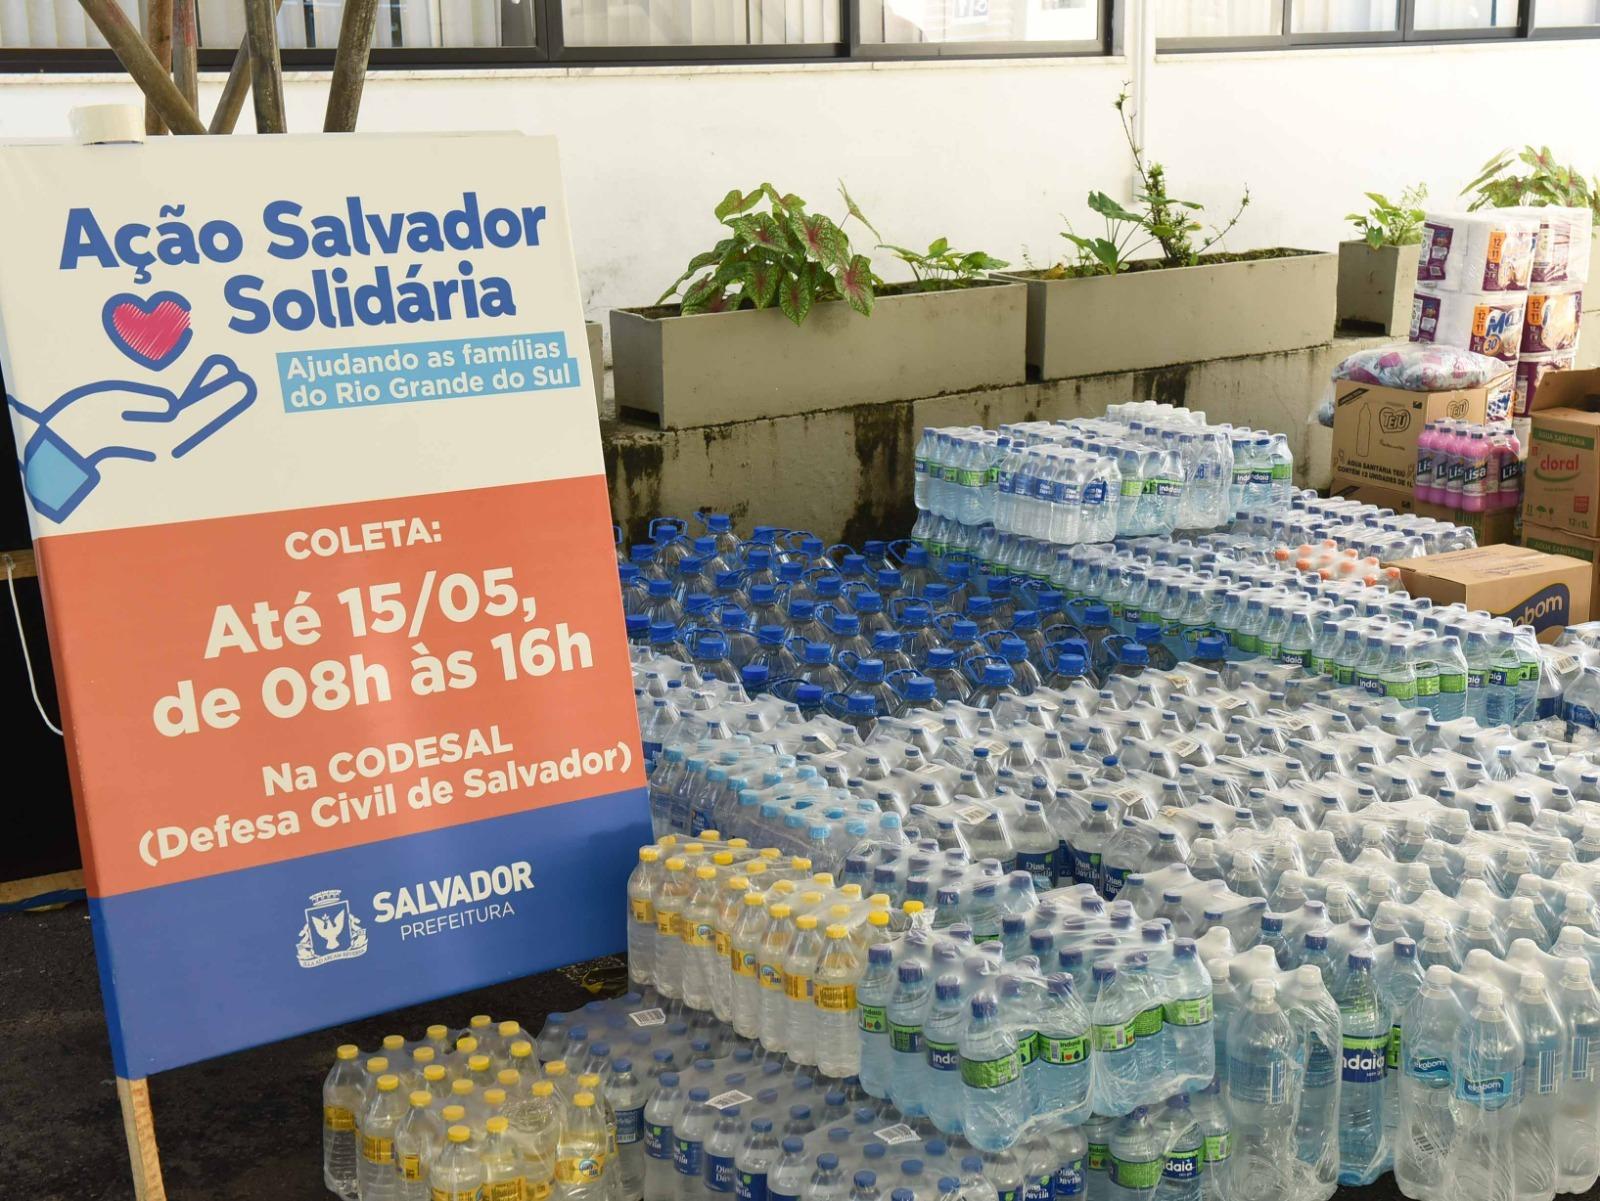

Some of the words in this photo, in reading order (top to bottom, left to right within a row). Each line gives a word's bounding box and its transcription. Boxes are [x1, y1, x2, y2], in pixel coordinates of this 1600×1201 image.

[59, 204, 243, 285] Ação
[263, 192, 546, 260] Salvador
[225, 260, 517, 335] Solidária
[287, 350, 418, 382] Ajudando
[428, 351, 455, 368] as
[463, 340, 562, 365] famílias
[290, 384, 327, 408] do
[335, 380, 381, 404] Rio
[390, 372, 484, 399] Grande
[492, 369, 525, 390] do
[533, 364, 571, 386] Sul
[1540, 454, 1579, 471] cloral
[285, 518, 441, 560] COLETA:
[205, 591, 321, 659] Até
[338, 567, 536, 638] 15/05,
[153, 680, 241, 737] de
[262, 654, 392, 719] 08h
[411, 641, 477, 696] às
[491, 623, 593, 681] 16h
[263, 763, 317, 796] Na
[329, 726, 513, 783] CODESAL
[139, 810, 300, 867] (Defesa
[311, 784, 397, 828] Civil
[408, 777, 454, 810] de
[464, 742, 633, 798] Salvador)
[373, 861, 535, 923] SALVADOR
[400, 902, 516, 941] PREFEITURA
